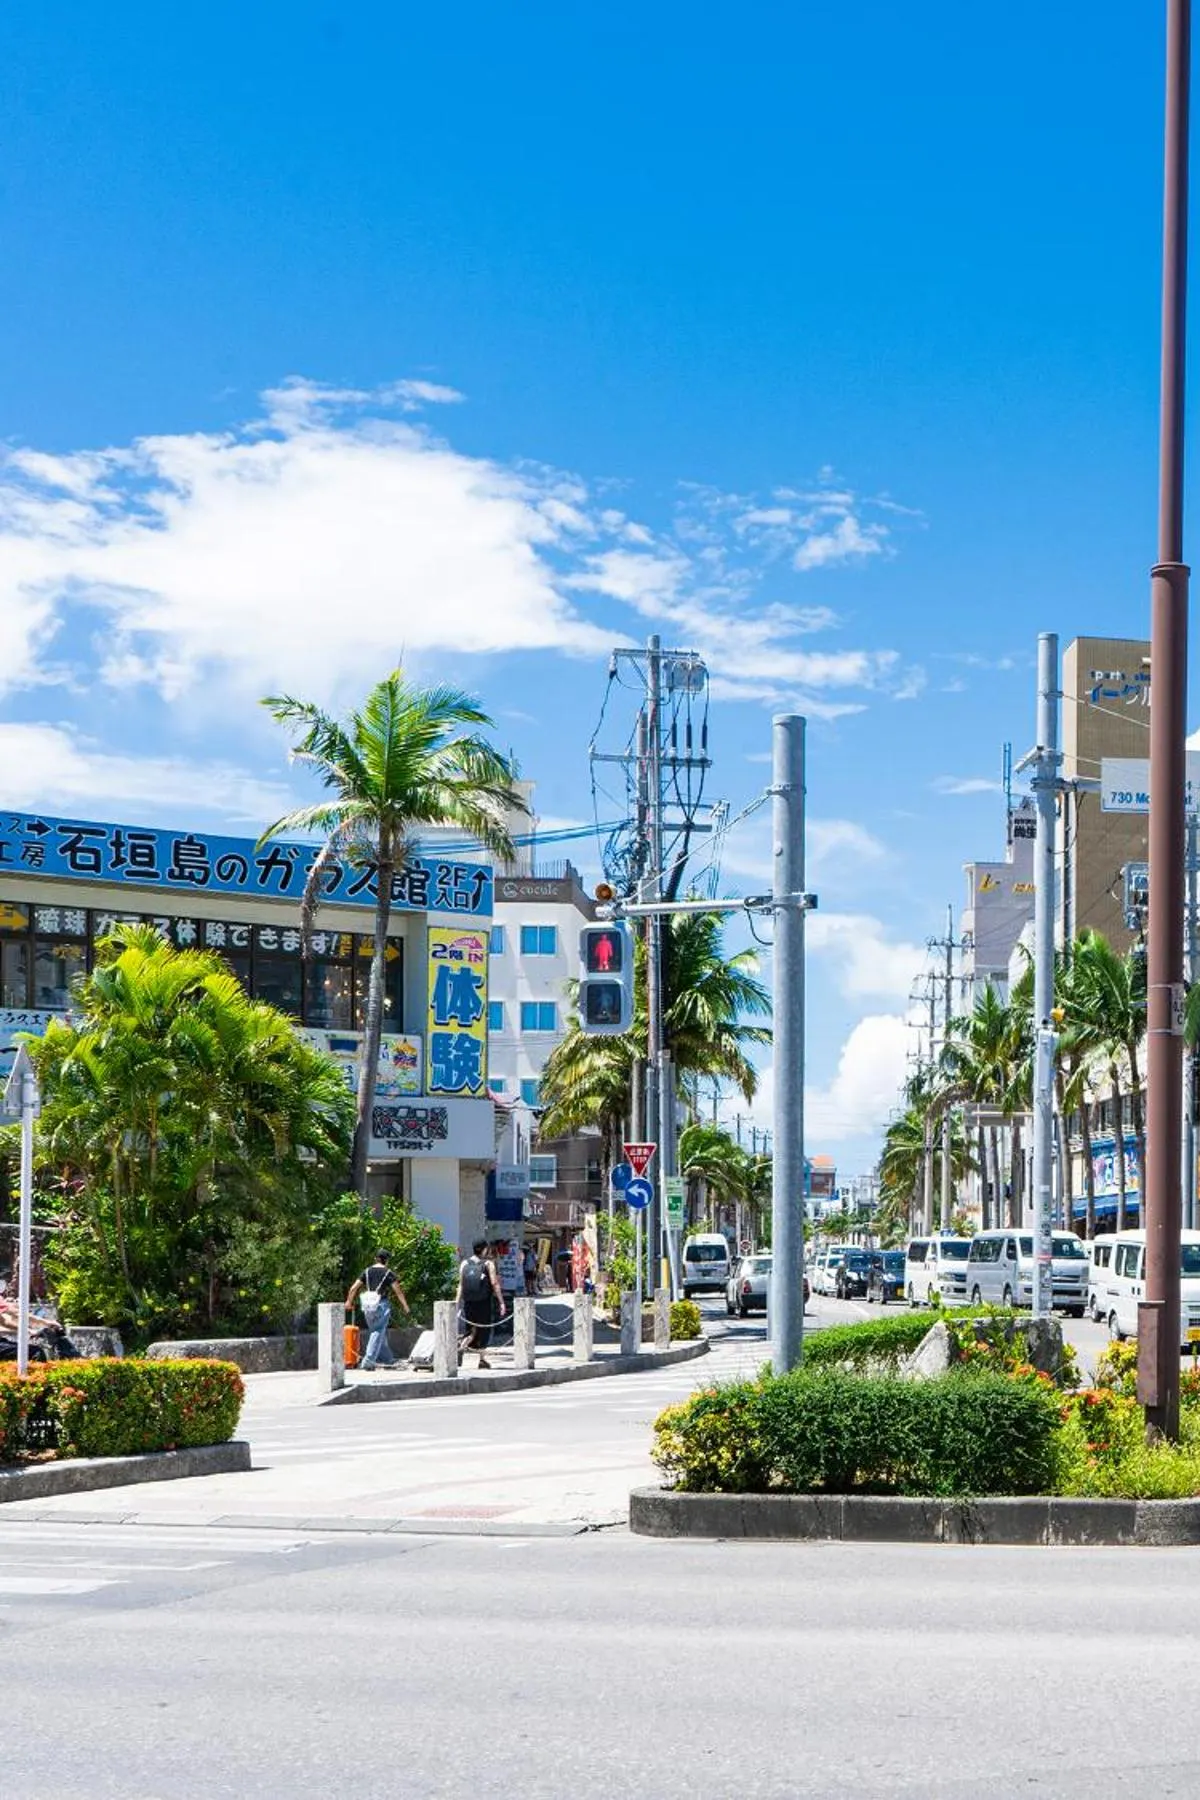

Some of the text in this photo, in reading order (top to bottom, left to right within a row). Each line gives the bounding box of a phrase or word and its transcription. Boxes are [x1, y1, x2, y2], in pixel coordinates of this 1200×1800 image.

[1110, 791, 1133, 804] 730
[436, 864, 468, 889] 2F
[434, 887, 473, 912] 入口
[430, 964, 484, 1093] 体験
